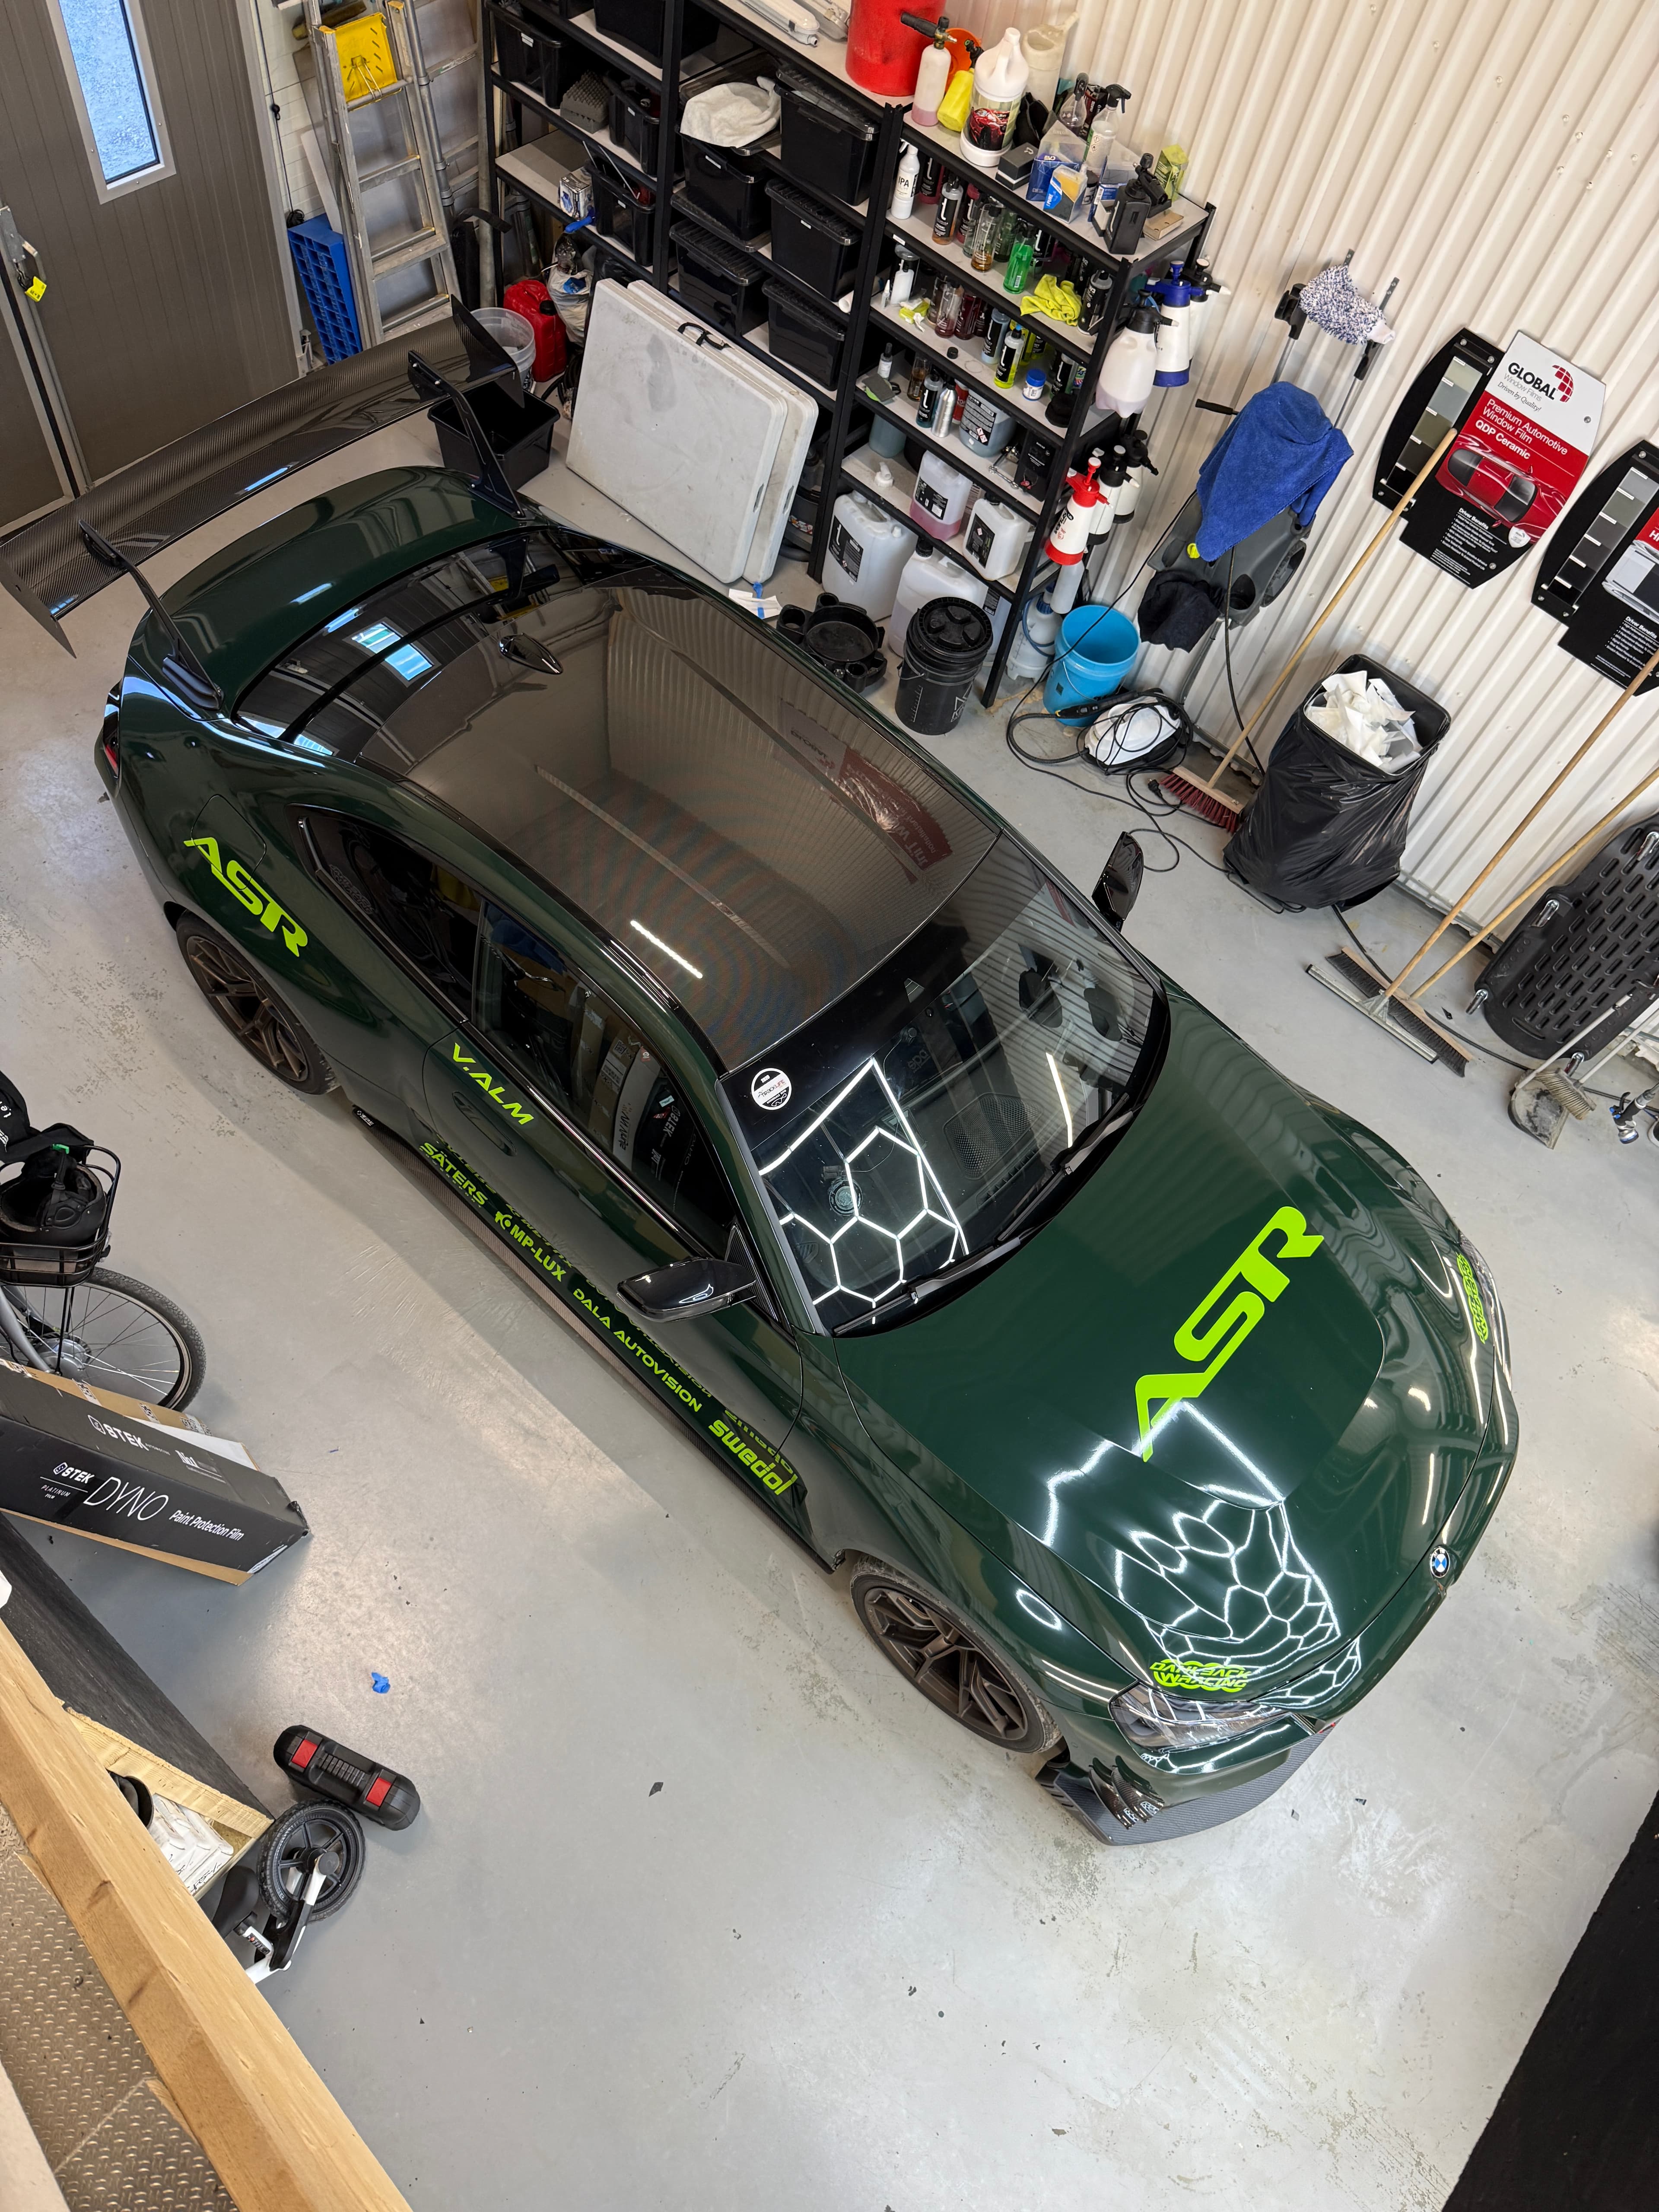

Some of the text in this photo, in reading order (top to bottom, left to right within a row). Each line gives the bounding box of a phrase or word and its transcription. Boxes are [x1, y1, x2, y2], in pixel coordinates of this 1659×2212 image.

[899, 176, 909, 187] IPA
[1498, 382, 1541, 412] Driven by Quality!
[1504, 373, 1542, 401] Window Films
[1508, 362, 1555, 400] GLOBAL
[1475, 420, 1531, 459] QDP Ceramic
[1483, 406, 1533, 444] Window Film
[1487, 399, 1568, 455] Premium Automotive
[1459, 508, 1489, 530] Driver Benefits
[1625, 616, 1657, 639] Driver Benefits
[184, 837, 308, 957] ASR
[452, 1042, 534, 1125] V.ALM
[420, 1142, 488, 1205] SÄTERS
[573, 1288, 702, 1412] DALA AUTOVISION
[1135, 1206, 1324, 1462] ASR
[103, 1423, 149, 1451] STEK
[41, 1484, 70, 1497] PLATINUM
[62, 1467, 95, 1484] STEK
[83, 1476, 169, 1521] DYNO
[168, 1510, 245, 1541] Paint Protection Film
